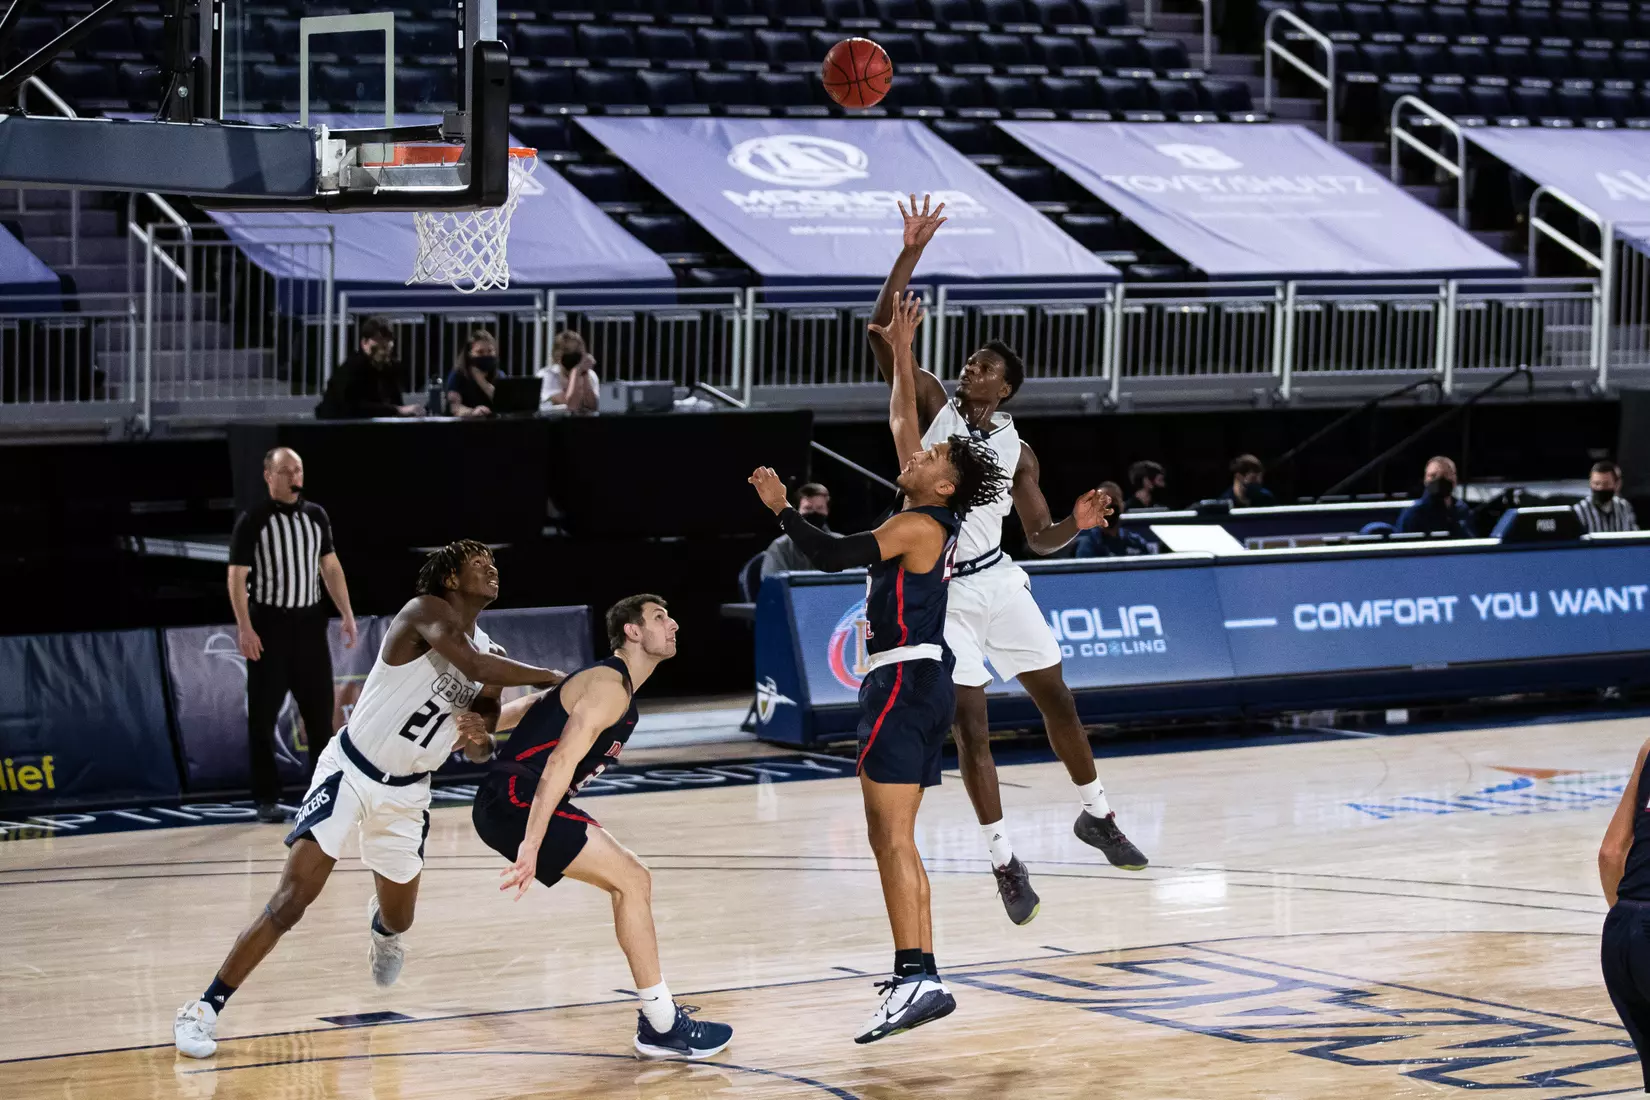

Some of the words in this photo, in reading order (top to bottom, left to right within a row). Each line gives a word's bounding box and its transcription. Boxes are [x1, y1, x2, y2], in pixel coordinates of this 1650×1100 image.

[1294, 596, 1458, 631] COMFORT
[1470, 592, 1538, 620] YOU
[1549, 585, 1648, 616] WANT
[431, 672, 475, 708] CBU
[399, 700, 452, 749] 21
